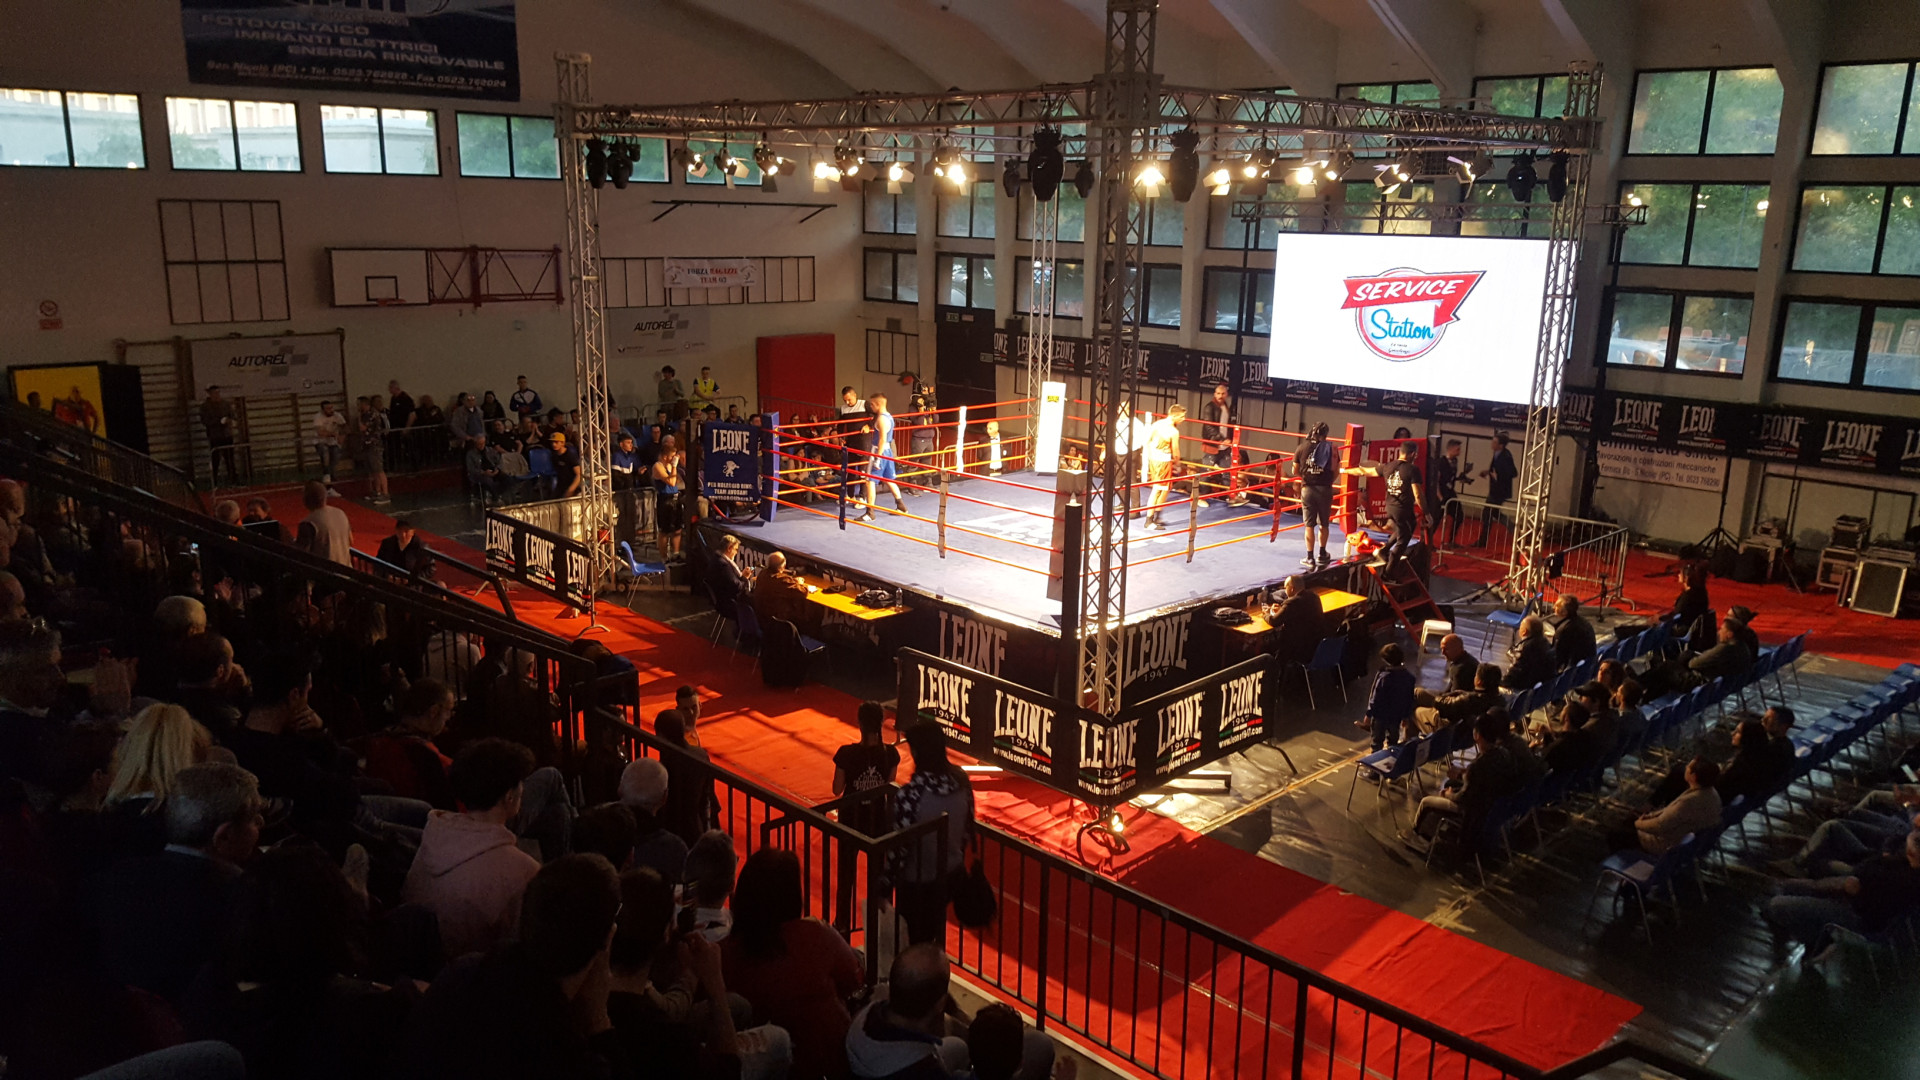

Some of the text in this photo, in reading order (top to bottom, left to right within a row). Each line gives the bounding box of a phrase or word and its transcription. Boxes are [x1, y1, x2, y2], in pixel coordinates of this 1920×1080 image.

[202, 14, 369, 36] FOTOVOLTAICO
[235, 30, 438, 54] IMPIANTI ELETTRICI
[288, 45, 505, 71] ENERGIA RINNOVABILE
[1353, 279, 1465, 302] SERVICE
[634, 320, 675, 332] AUTOREL
[1371, 308, 1435, 340] Station
[228, 354, 287, 368] AUTOREL
[1200, 356, 1230, 382] LEONE
[1612, 397, 1663, 432] LEONE
[712, 428, 750, 456] LEONE
[1821, 420, 1884, 459] LEONE
[486, 517, 516, 562] LEONE
[525, 532, 556, 580] LEONE
[939, 610, 1008, 679] LEONE
[1123, 613, 1193, 689] LEONE
[1144, 666, 1170, 682] 1947
[917, 663, 972, 728] LEONE
[1219, 670, 1265, 732] LEONE
[934, 708, 955, 722] 1947
[994, 689, 1055, 759] LEONE
[1156, 691, 1204, 759] LEONE
[1232, 714, 1250, 727] 1947
[1011, 736, 1035, 751] 1947
[1078, 719, 1140, 769] LEONE
[1170, 738, 1189, 752] 1947
[993, 746, 1052, 776] www.leone1947.com
